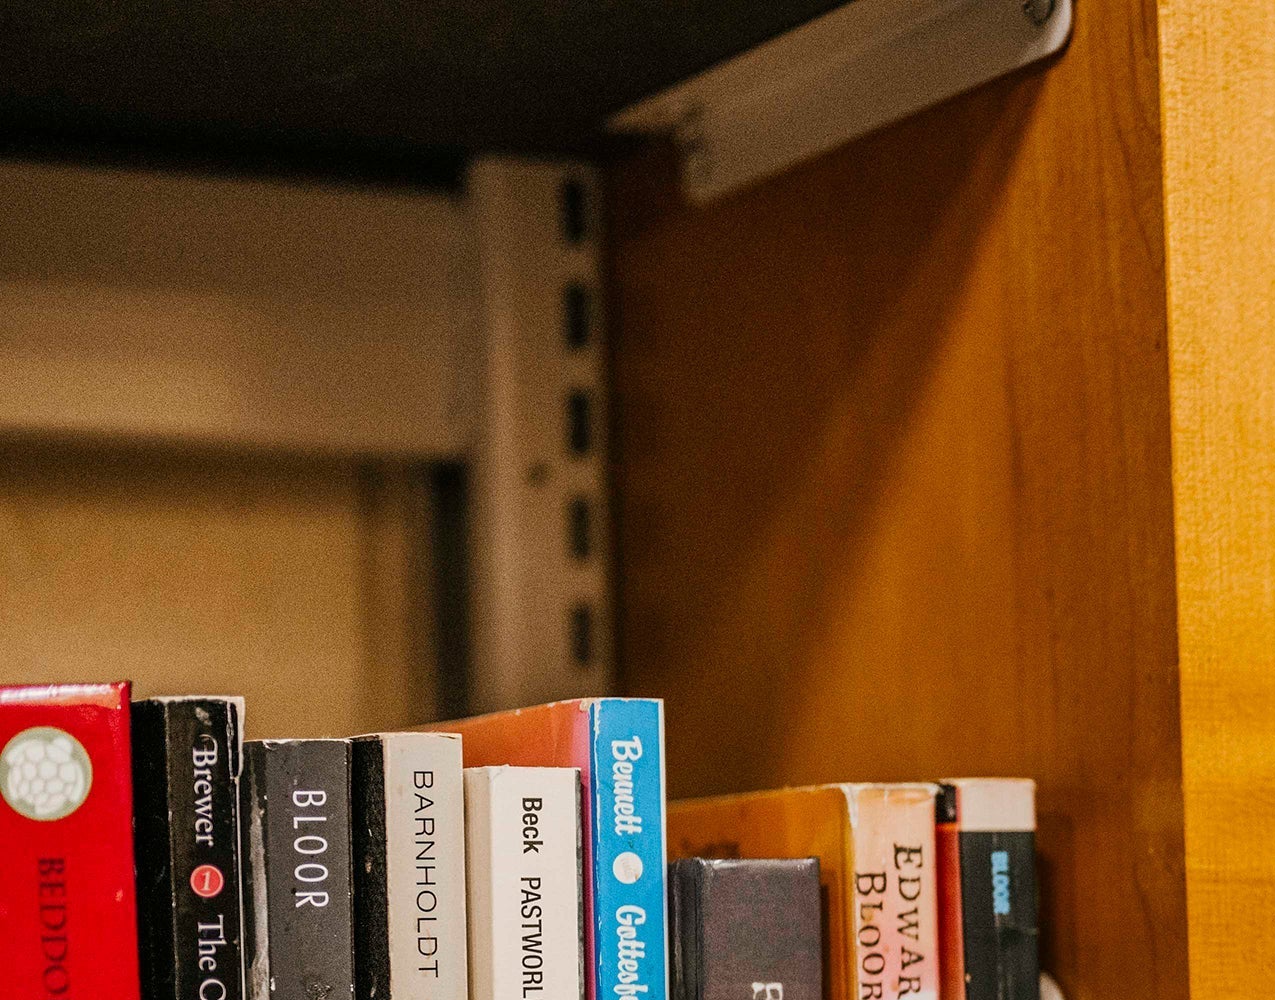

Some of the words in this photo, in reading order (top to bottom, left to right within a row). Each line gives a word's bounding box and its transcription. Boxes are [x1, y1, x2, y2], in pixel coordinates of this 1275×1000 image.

[192, 734, 219, 847] Brewer
[522, 797, 543, 854] Beck
[611, 735, 643, 837] Bennett
[292, 790, 329, 908] BLOOR
[413, 770, 439, 978] BARNHOLDT
[197, 914, 228, 972] The
